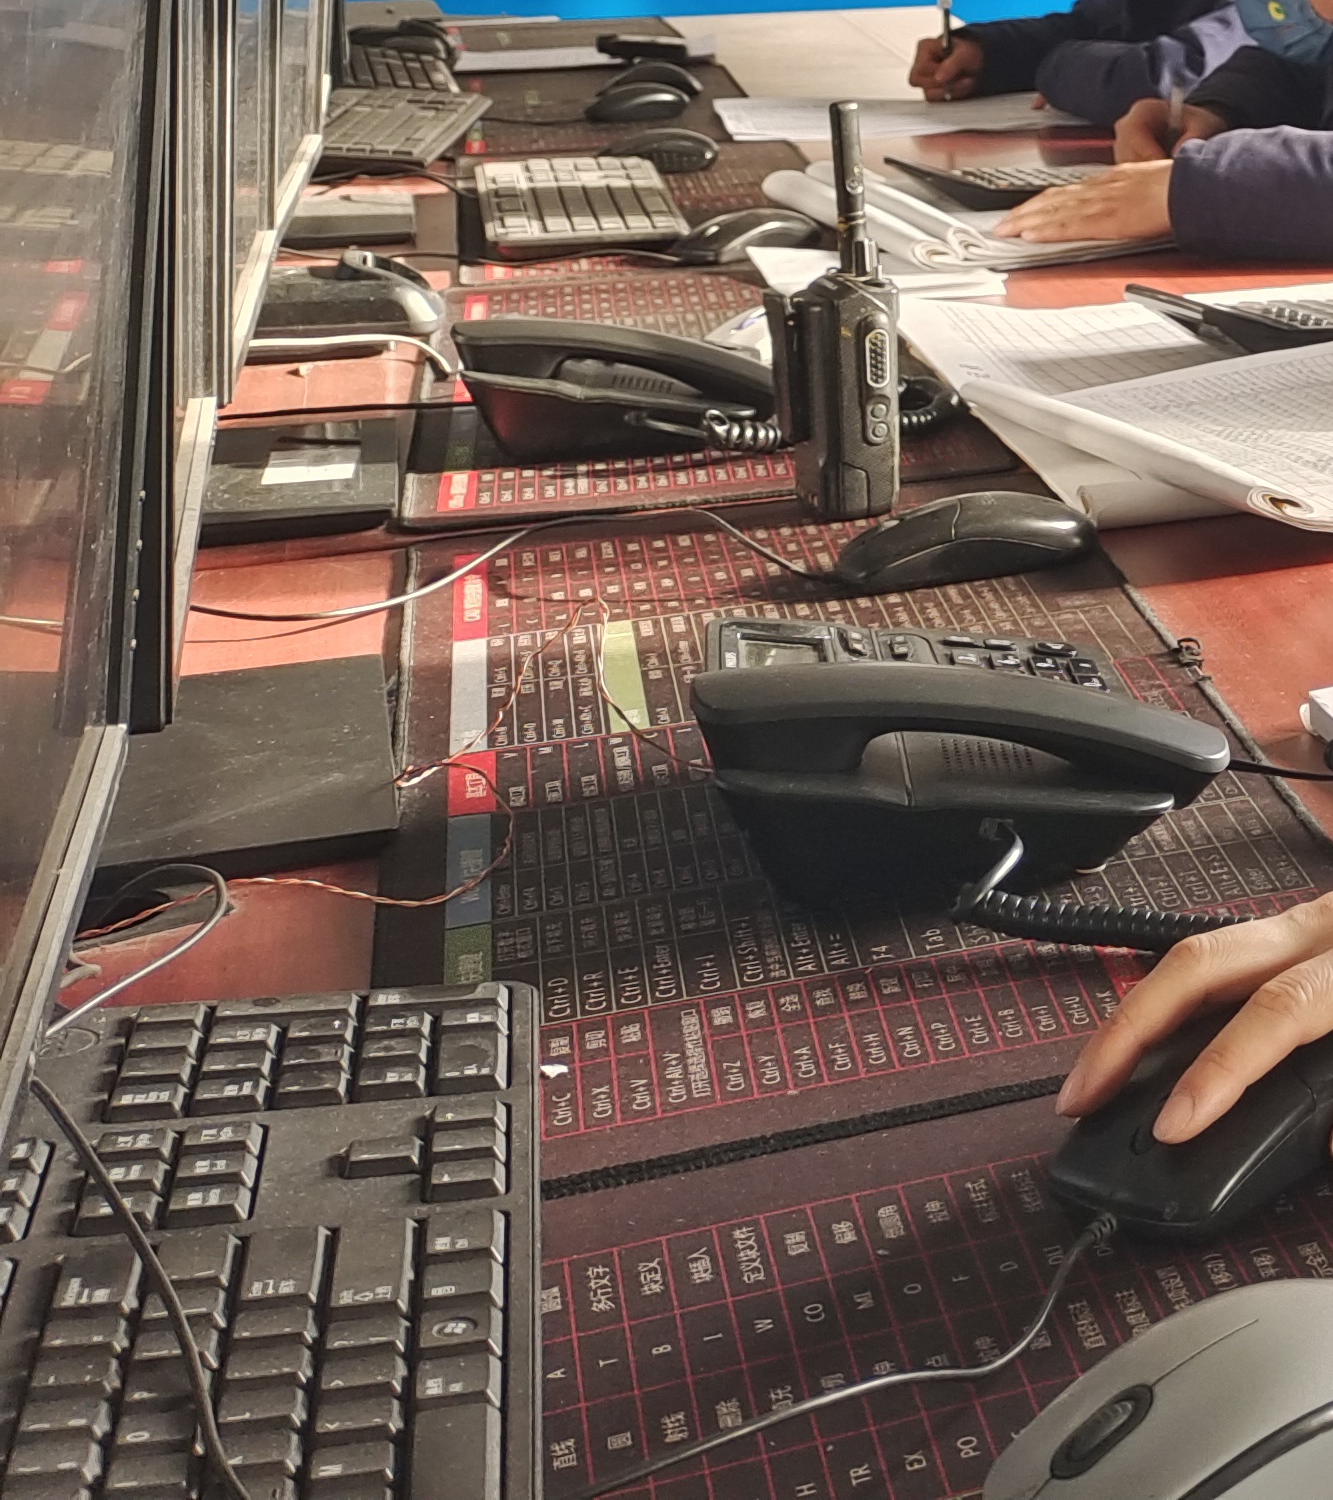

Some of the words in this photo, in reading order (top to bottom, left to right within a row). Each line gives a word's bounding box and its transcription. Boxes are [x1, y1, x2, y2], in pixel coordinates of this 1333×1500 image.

[828, 932, 850, 966] Alt+=
[871, 945, 895, 961] F4
[921, 927, 945, 951] Tab
[619, 966, 642, 1004] Ctrl+E
[653, 944, 677, 998] Ctrl+Enter
[548, 977, 571, 1017] Ctrl+D
[583, 971, 606, 1011] Ctrl+R
[998, 1008, 1024, 1038] Ctrl+B
[1063, 996, 1090, 1025] Ctrl+U
[585, 1030, 607, 1049] 剪切
[620, 1023, 642, 1043] 粘贴
[897, 1026, 922, 1058] Ctrl+N
[931, 1022, 956, 1051] Ctrl+P
[965, 1014, 990, 1044] Ctrl+E
[794, 1045, 817, 1079] Ctrl+A
[828, 1042, 851, 1071] Ctrl+F
[864, 1033, 887, 1064] Ctrl+H
[662, 1051, 687, 1103] Ctrl+Alt+V
[723, 1060, 745, 1092] Ctrl+Z
[758, 1055, 780, 1085] Ctrl+Y
[552, 1092, 572, 1126] Ctrl+C
[592, 1085, 612, 1118] Ctrl+X
[630, 1079, 650, 1110] Ctrl+V
[687, 1247, 713, 1284] 块插入
[733, 1226, 765, 1283] 定义块文件
[1000, 1262, 1018, 1272] D
[587, 1265, 615, 1312] 多行文字
[638, 1257, 664, 1296] 块定义
[952, 1274, 969, 1283] F
[754, 1318, 773, 1333] W
[804, 1303, 824, 1322] CO
[599, 1358, 618, 1367] T
[652, 1344, 672, 1355] B
[546, 1367, 567, 1379] A
[551, 1438, 577, 1471] 直线
[905, 1450, 927, 1471] EX
[956, 1436, 981, 1458] PO
[794, 1482, 817, 1497] H
[850, 1463, 872, 1486] TR
